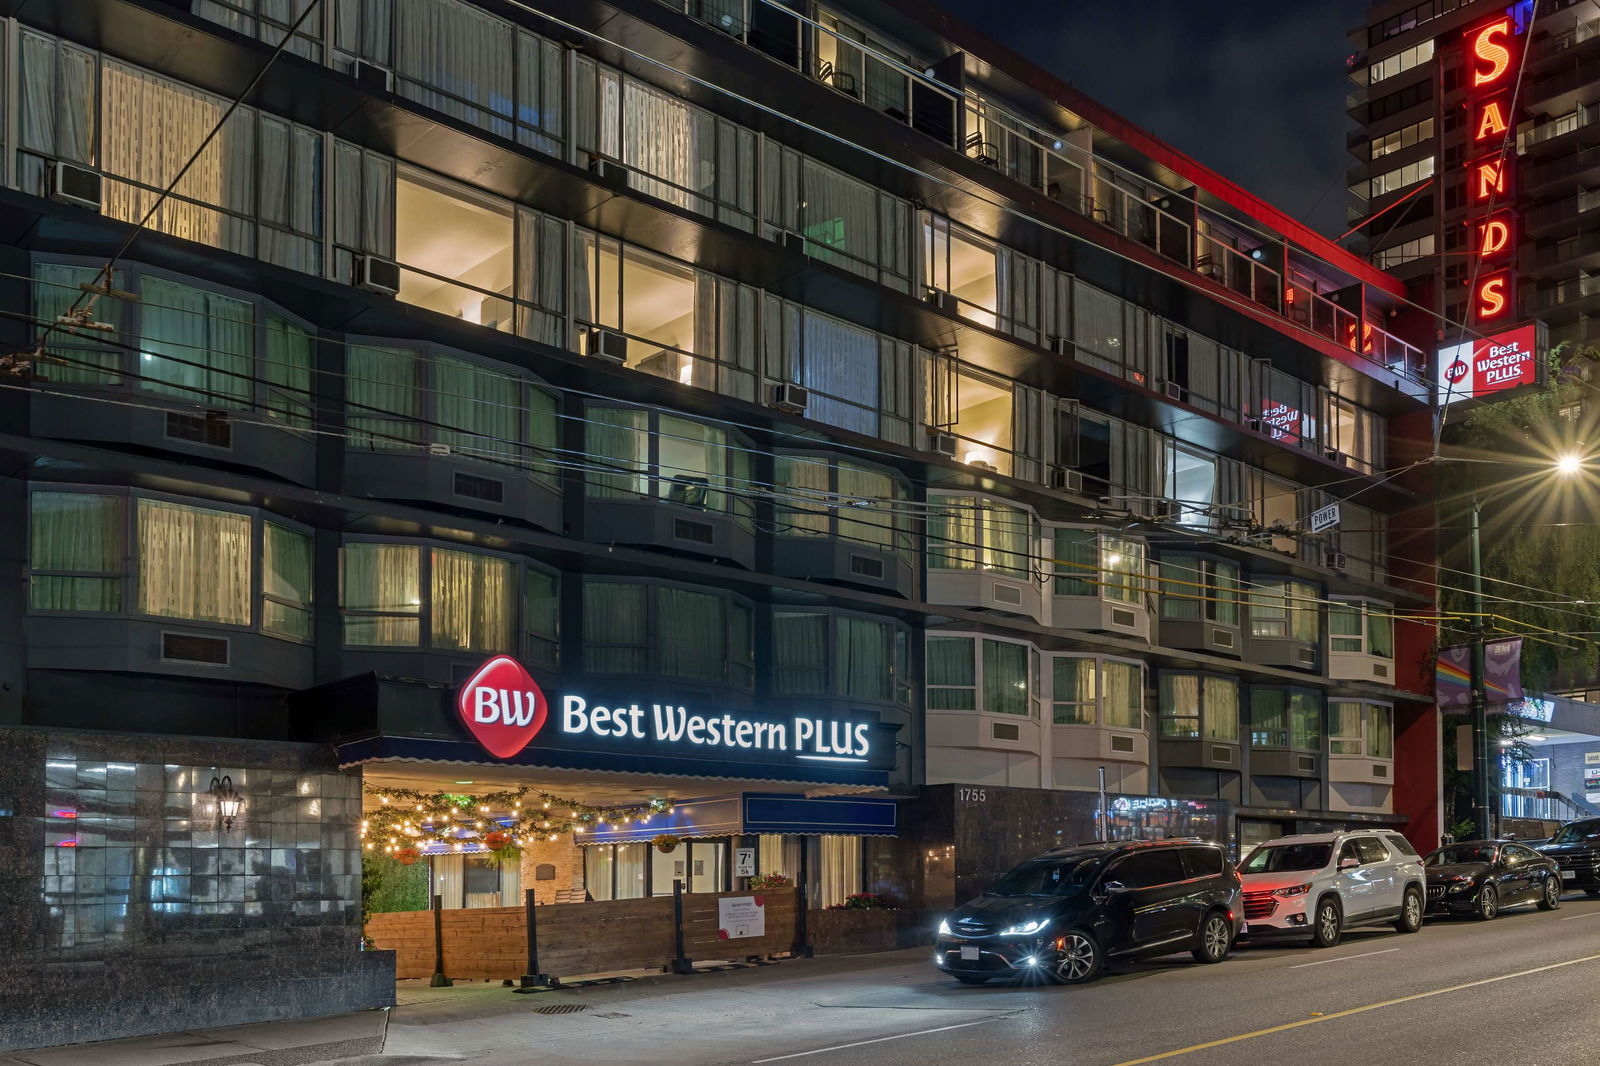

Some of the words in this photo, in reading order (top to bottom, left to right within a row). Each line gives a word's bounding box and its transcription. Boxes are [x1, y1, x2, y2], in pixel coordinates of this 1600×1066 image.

[1474, 21, 1510, 316] SANDS
[1489, 342, 1519, 358] Best
[1477, 351, 1531, 372] Western
[1314, 507, 1337, 526] POWER
[474, 686, 535, 727] BW
[562, 695, 645, 739] Best
[653, 704, 787, 751] Western
[795, 717, 870, 756] PLUS
[959, 788, 986, 801] 1755
